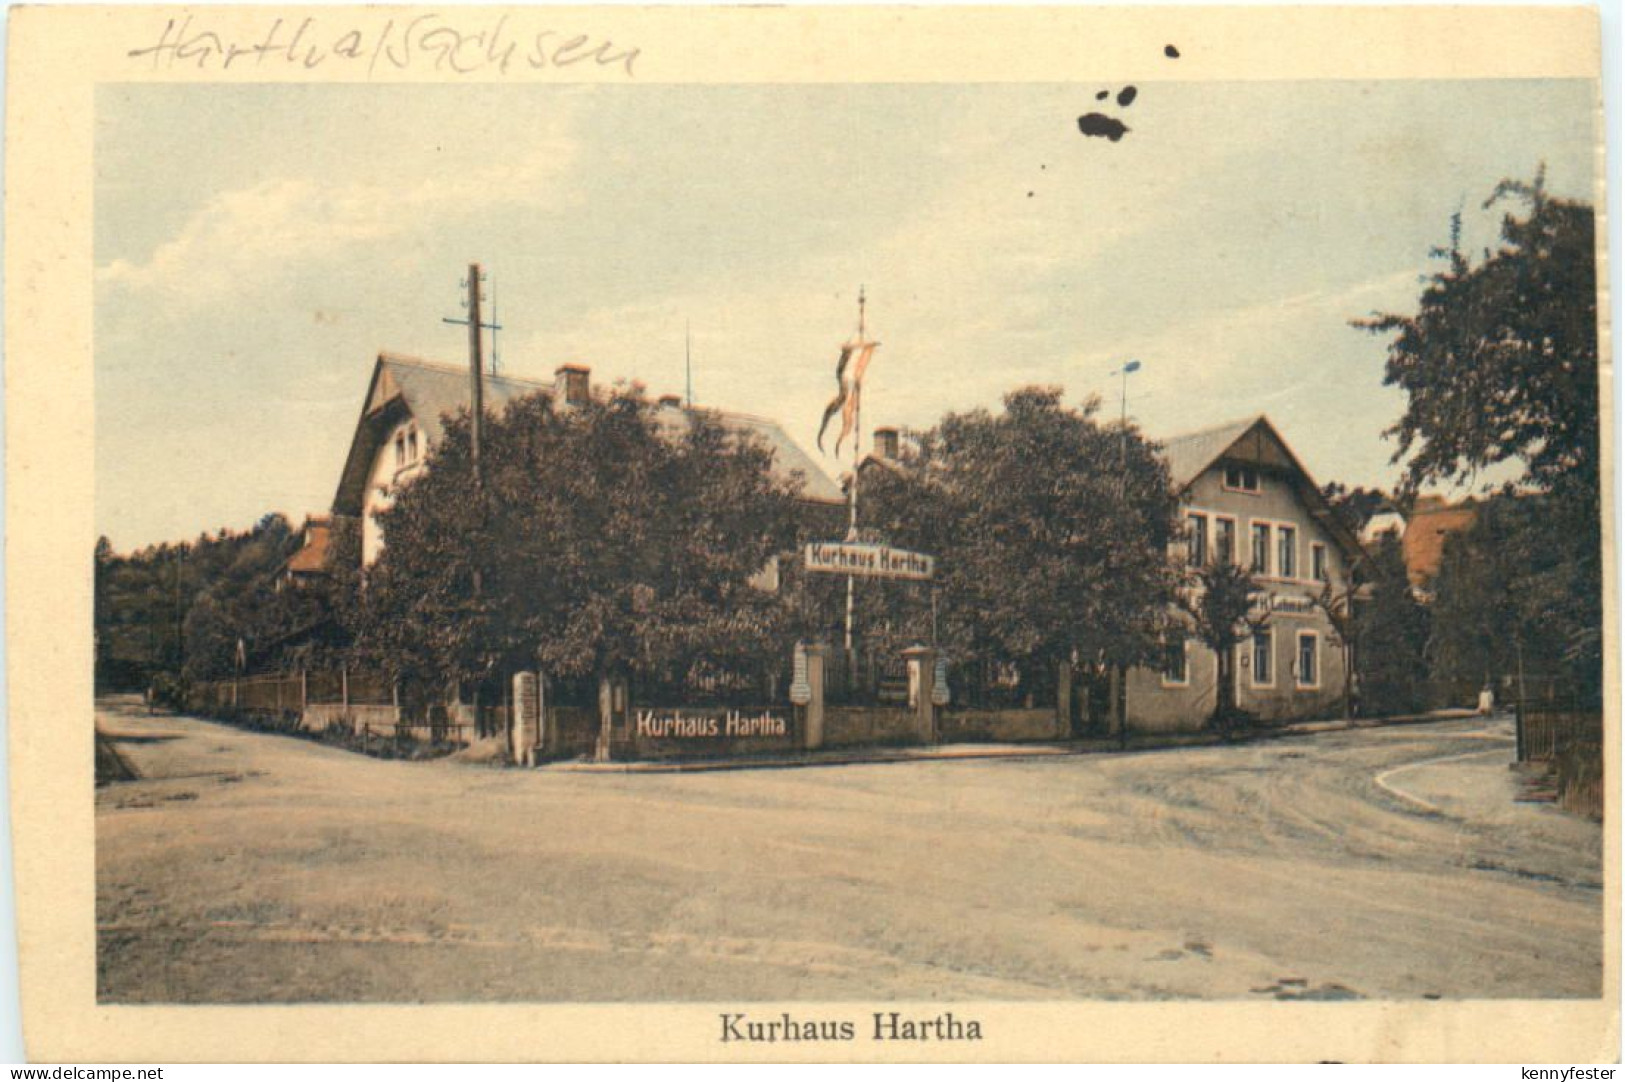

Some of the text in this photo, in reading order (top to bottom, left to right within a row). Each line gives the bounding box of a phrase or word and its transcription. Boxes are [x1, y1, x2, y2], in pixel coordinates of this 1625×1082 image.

[810, 543, 930, 574] Kurhaus Hartha
[636, 710, 787, 738] Kurhaus Hartha
